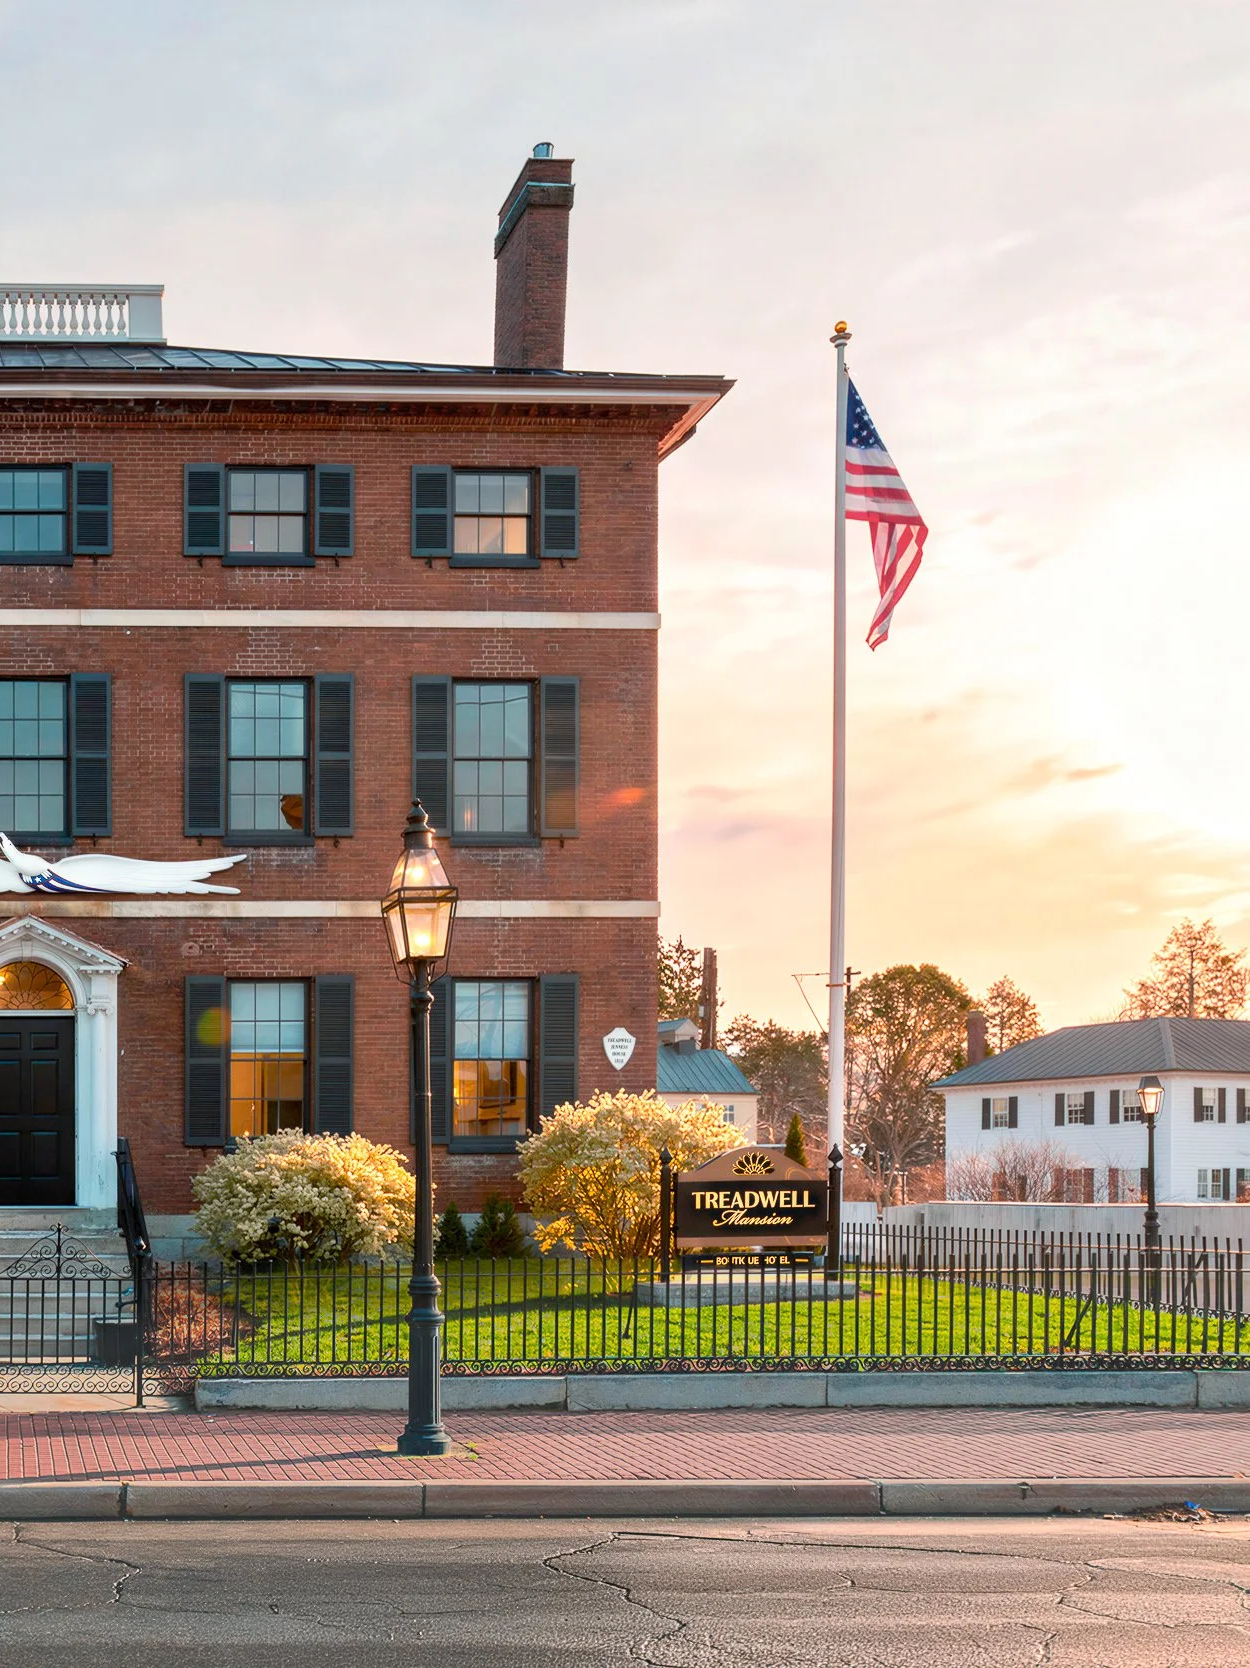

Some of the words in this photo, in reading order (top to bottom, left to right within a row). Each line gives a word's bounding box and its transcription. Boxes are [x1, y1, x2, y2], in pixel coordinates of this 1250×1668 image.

[691, 1190, 815, 1210] TREADWELL
[712, 1208, 794, 1227] Mansion
[762, 1255, 791, 1265] HOEL
